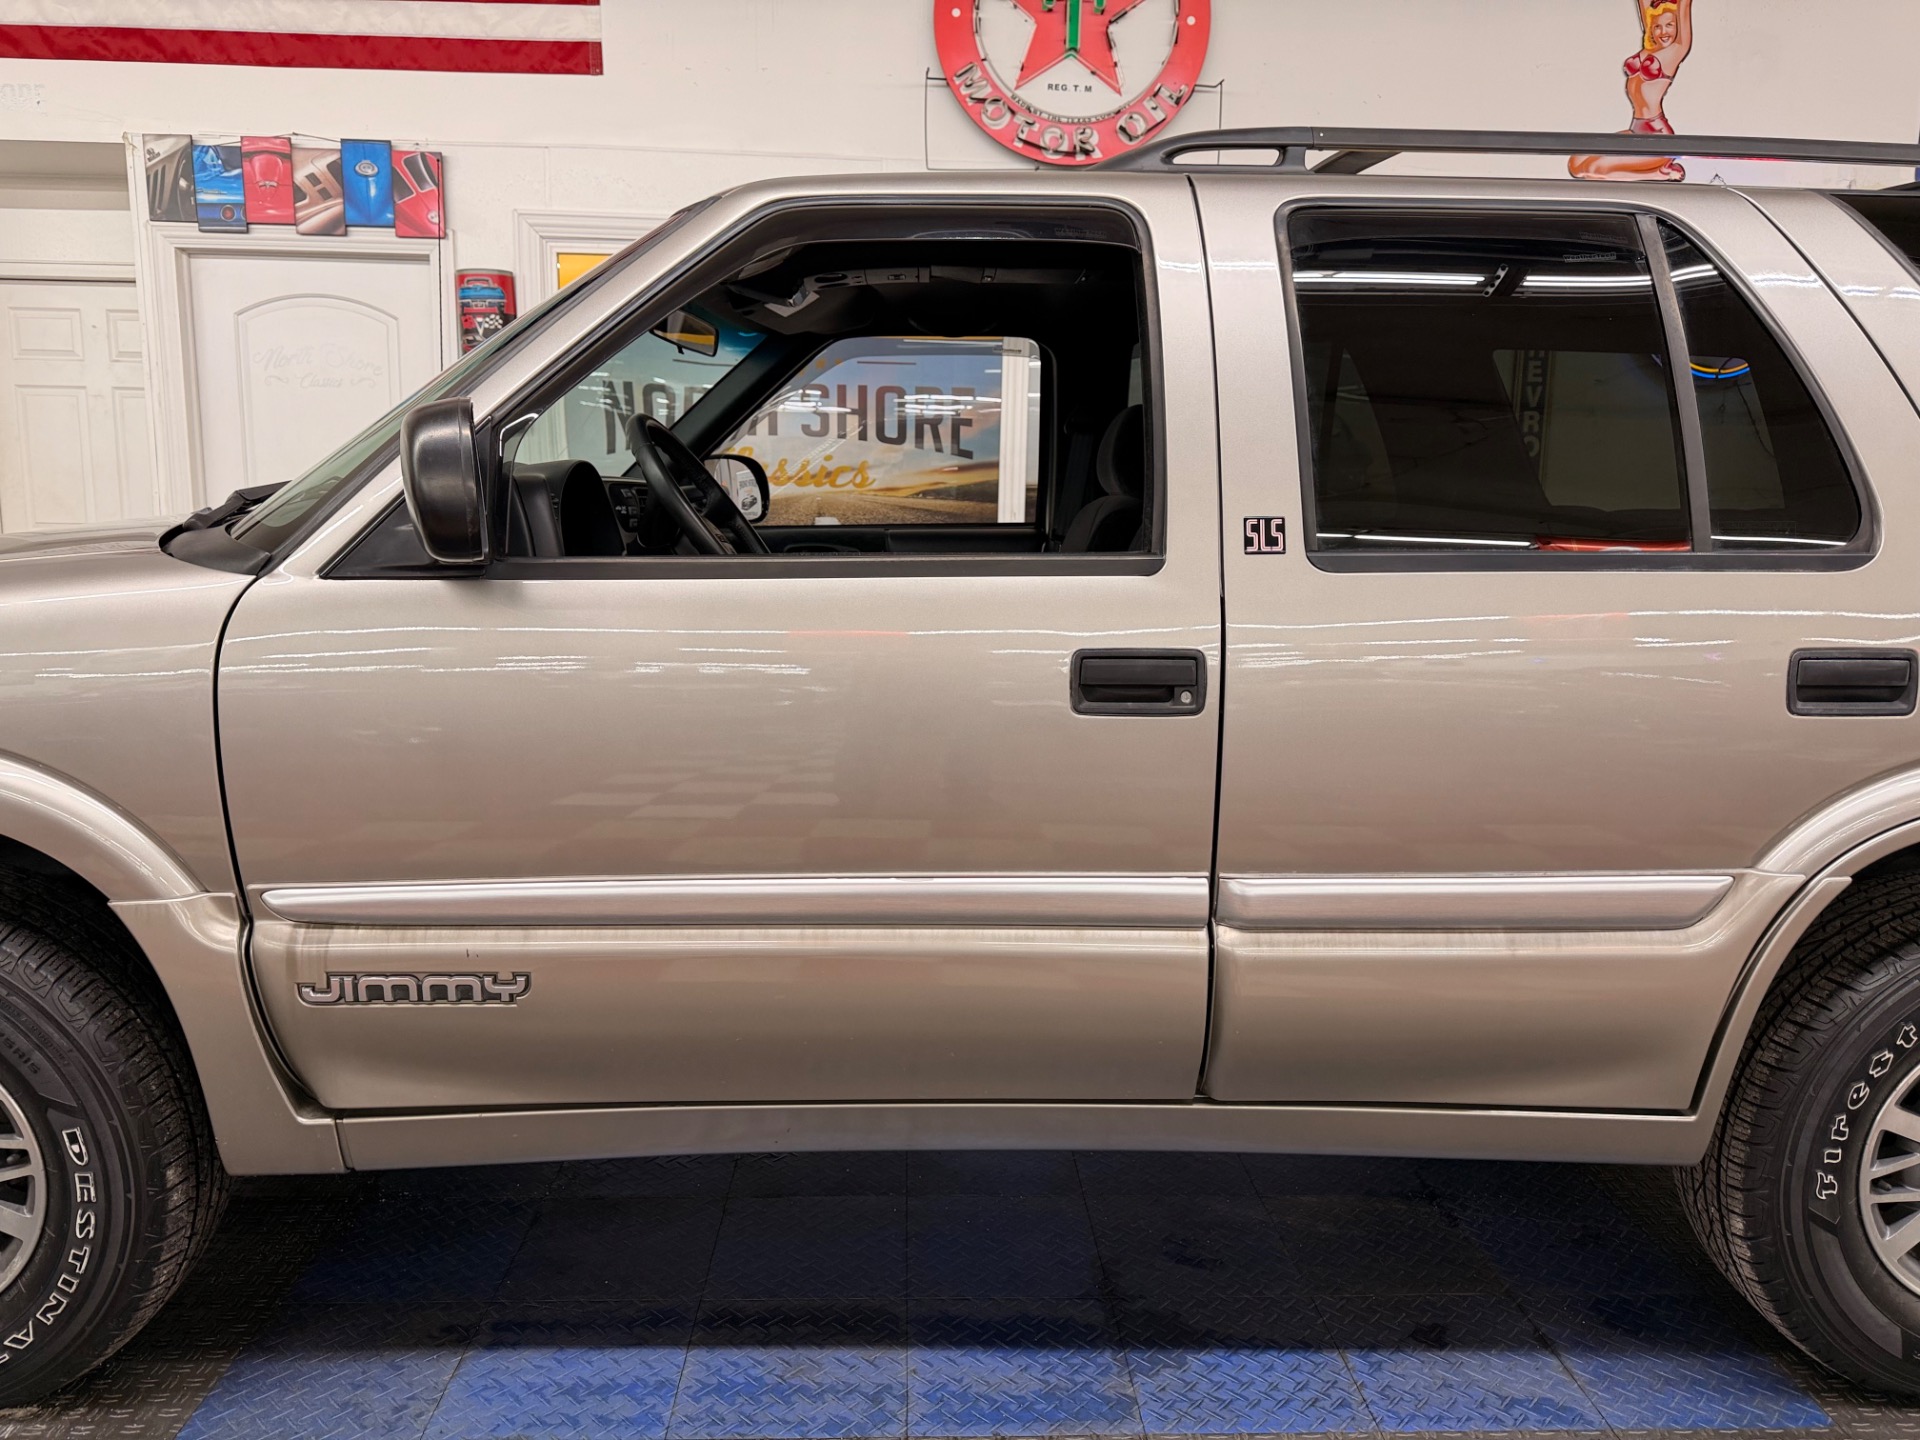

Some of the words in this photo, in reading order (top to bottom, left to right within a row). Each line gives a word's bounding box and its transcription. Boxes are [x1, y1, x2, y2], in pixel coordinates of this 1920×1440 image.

[953, 62, 1102, 160] MOTOR
[1116, 83, 1189, 145] OIL
[801, 383, 976, 460] SHORE
[1245, 518, 1284, 552] SLS
